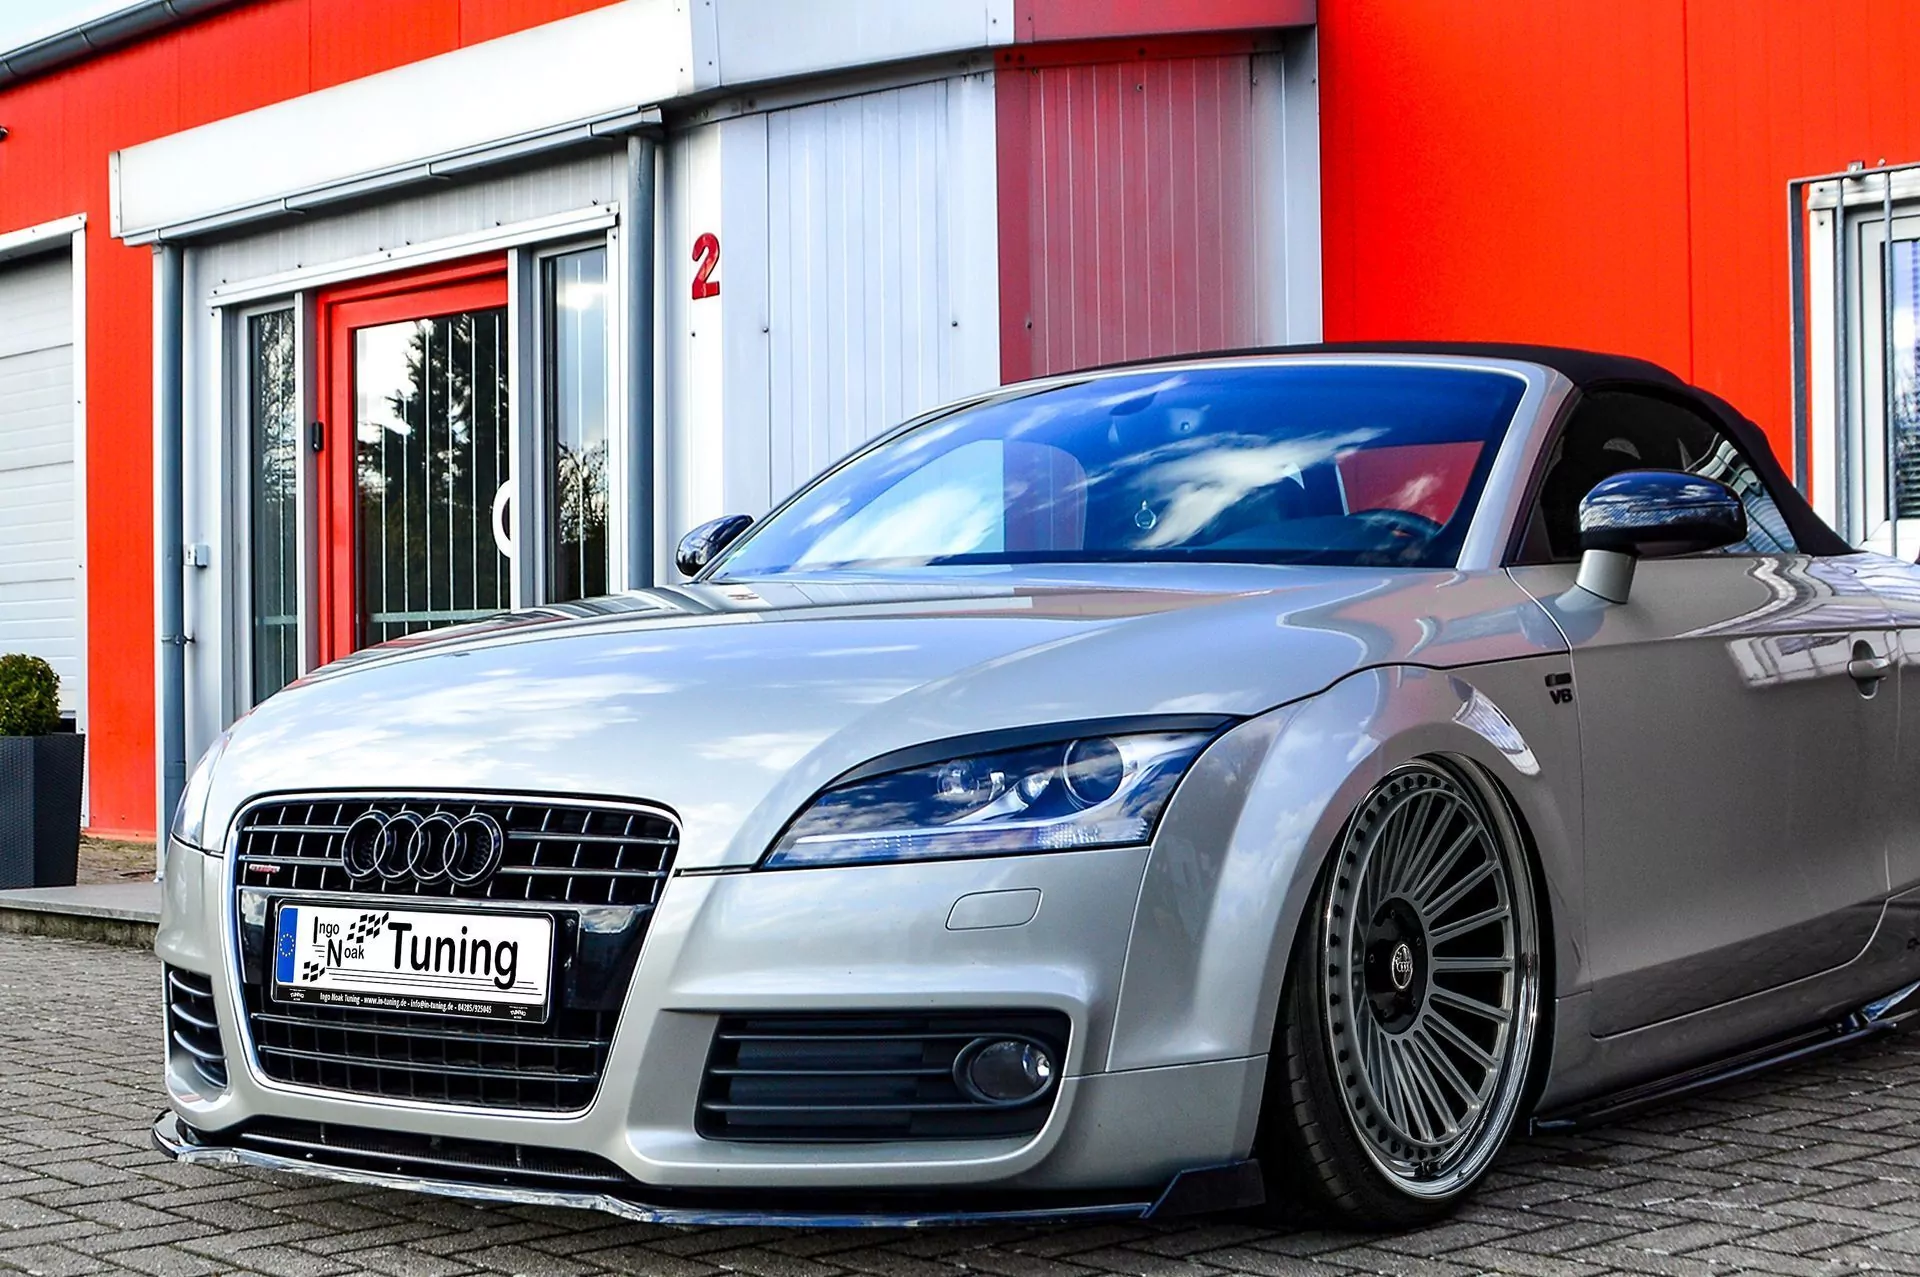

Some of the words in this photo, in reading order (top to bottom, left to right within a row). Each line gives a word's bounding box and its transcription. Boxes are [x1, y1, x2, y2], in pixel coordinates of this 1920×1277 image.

[692, 232, 720, 300] 2
[313, 916, 340, 944] Ingo
[326, 939, 365, 967] Noak
[388, 922, 518, 989] Tuning
[320, 992, 331, 1003] Ingo
[331, 993, 344, 1002] Noak
[344, 994, 361, 1006] Tuning
[363, 996, 407, 1009] www.in-tuning.de
[410, 999, 454, 1012] info@in-tuning.de
